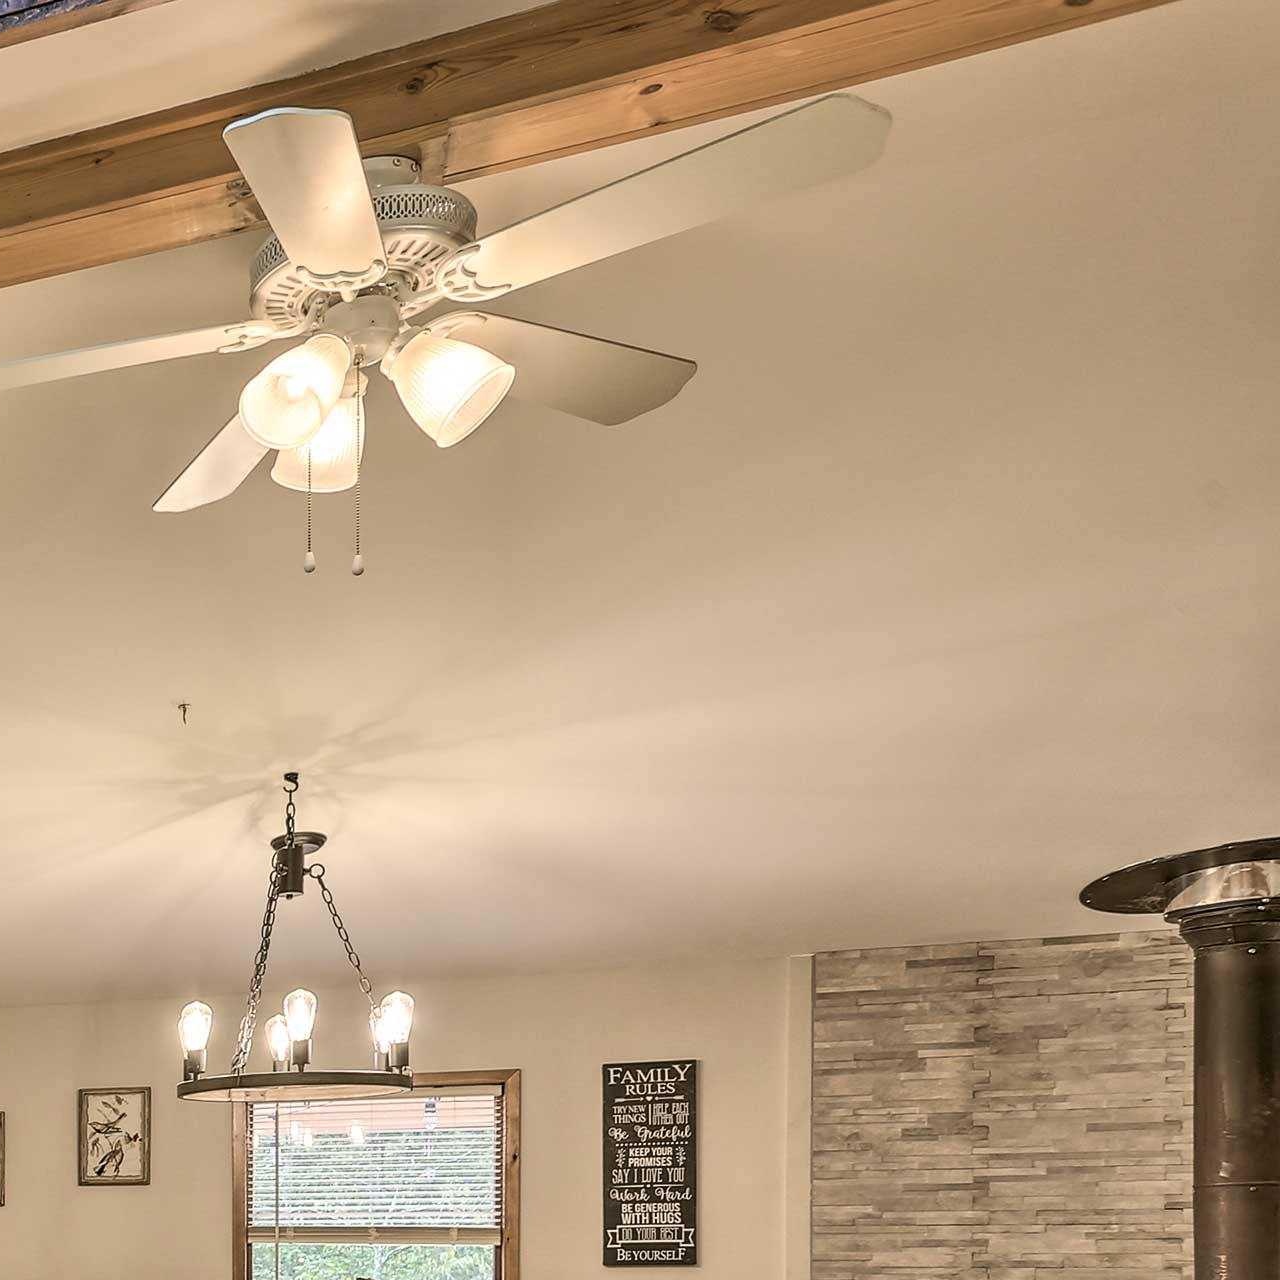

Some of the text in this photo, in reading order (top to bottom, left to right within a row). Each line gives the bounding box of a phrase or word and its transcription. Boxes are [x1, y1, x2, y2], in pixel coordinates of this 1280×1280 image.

[607, 1063, 692, 1085] FAMILY
[625, 1082, 676, 1095] RULES
[612, 1104, 646, 1114] TRY NEW
[653, 1102, 689, 1114] HELP EACH
[612, 1113, 646, 1123] THINGS
[652, 1114, 689, 1125] OTHER OUT
[608, 1124, 692, 1142] Be Grateful
[629, 1147, 673, 1156] KEEP YOUR
[628, 1157, 672, 1167] PROMISES
[612, 1167, 685, 1184] SAY I LOVE YOU
[609, 1187, 692, 1201] Work Hard
[622, 1203, 680, 1213] BE GENEROUS
[621, 1212, 681, 1224] WITH HUGS
[622, 1228, 632, 1240] DO
[636, 1228, 656, 1240] YOUR
[633, 1248, 686, 1261] YOURSELF
